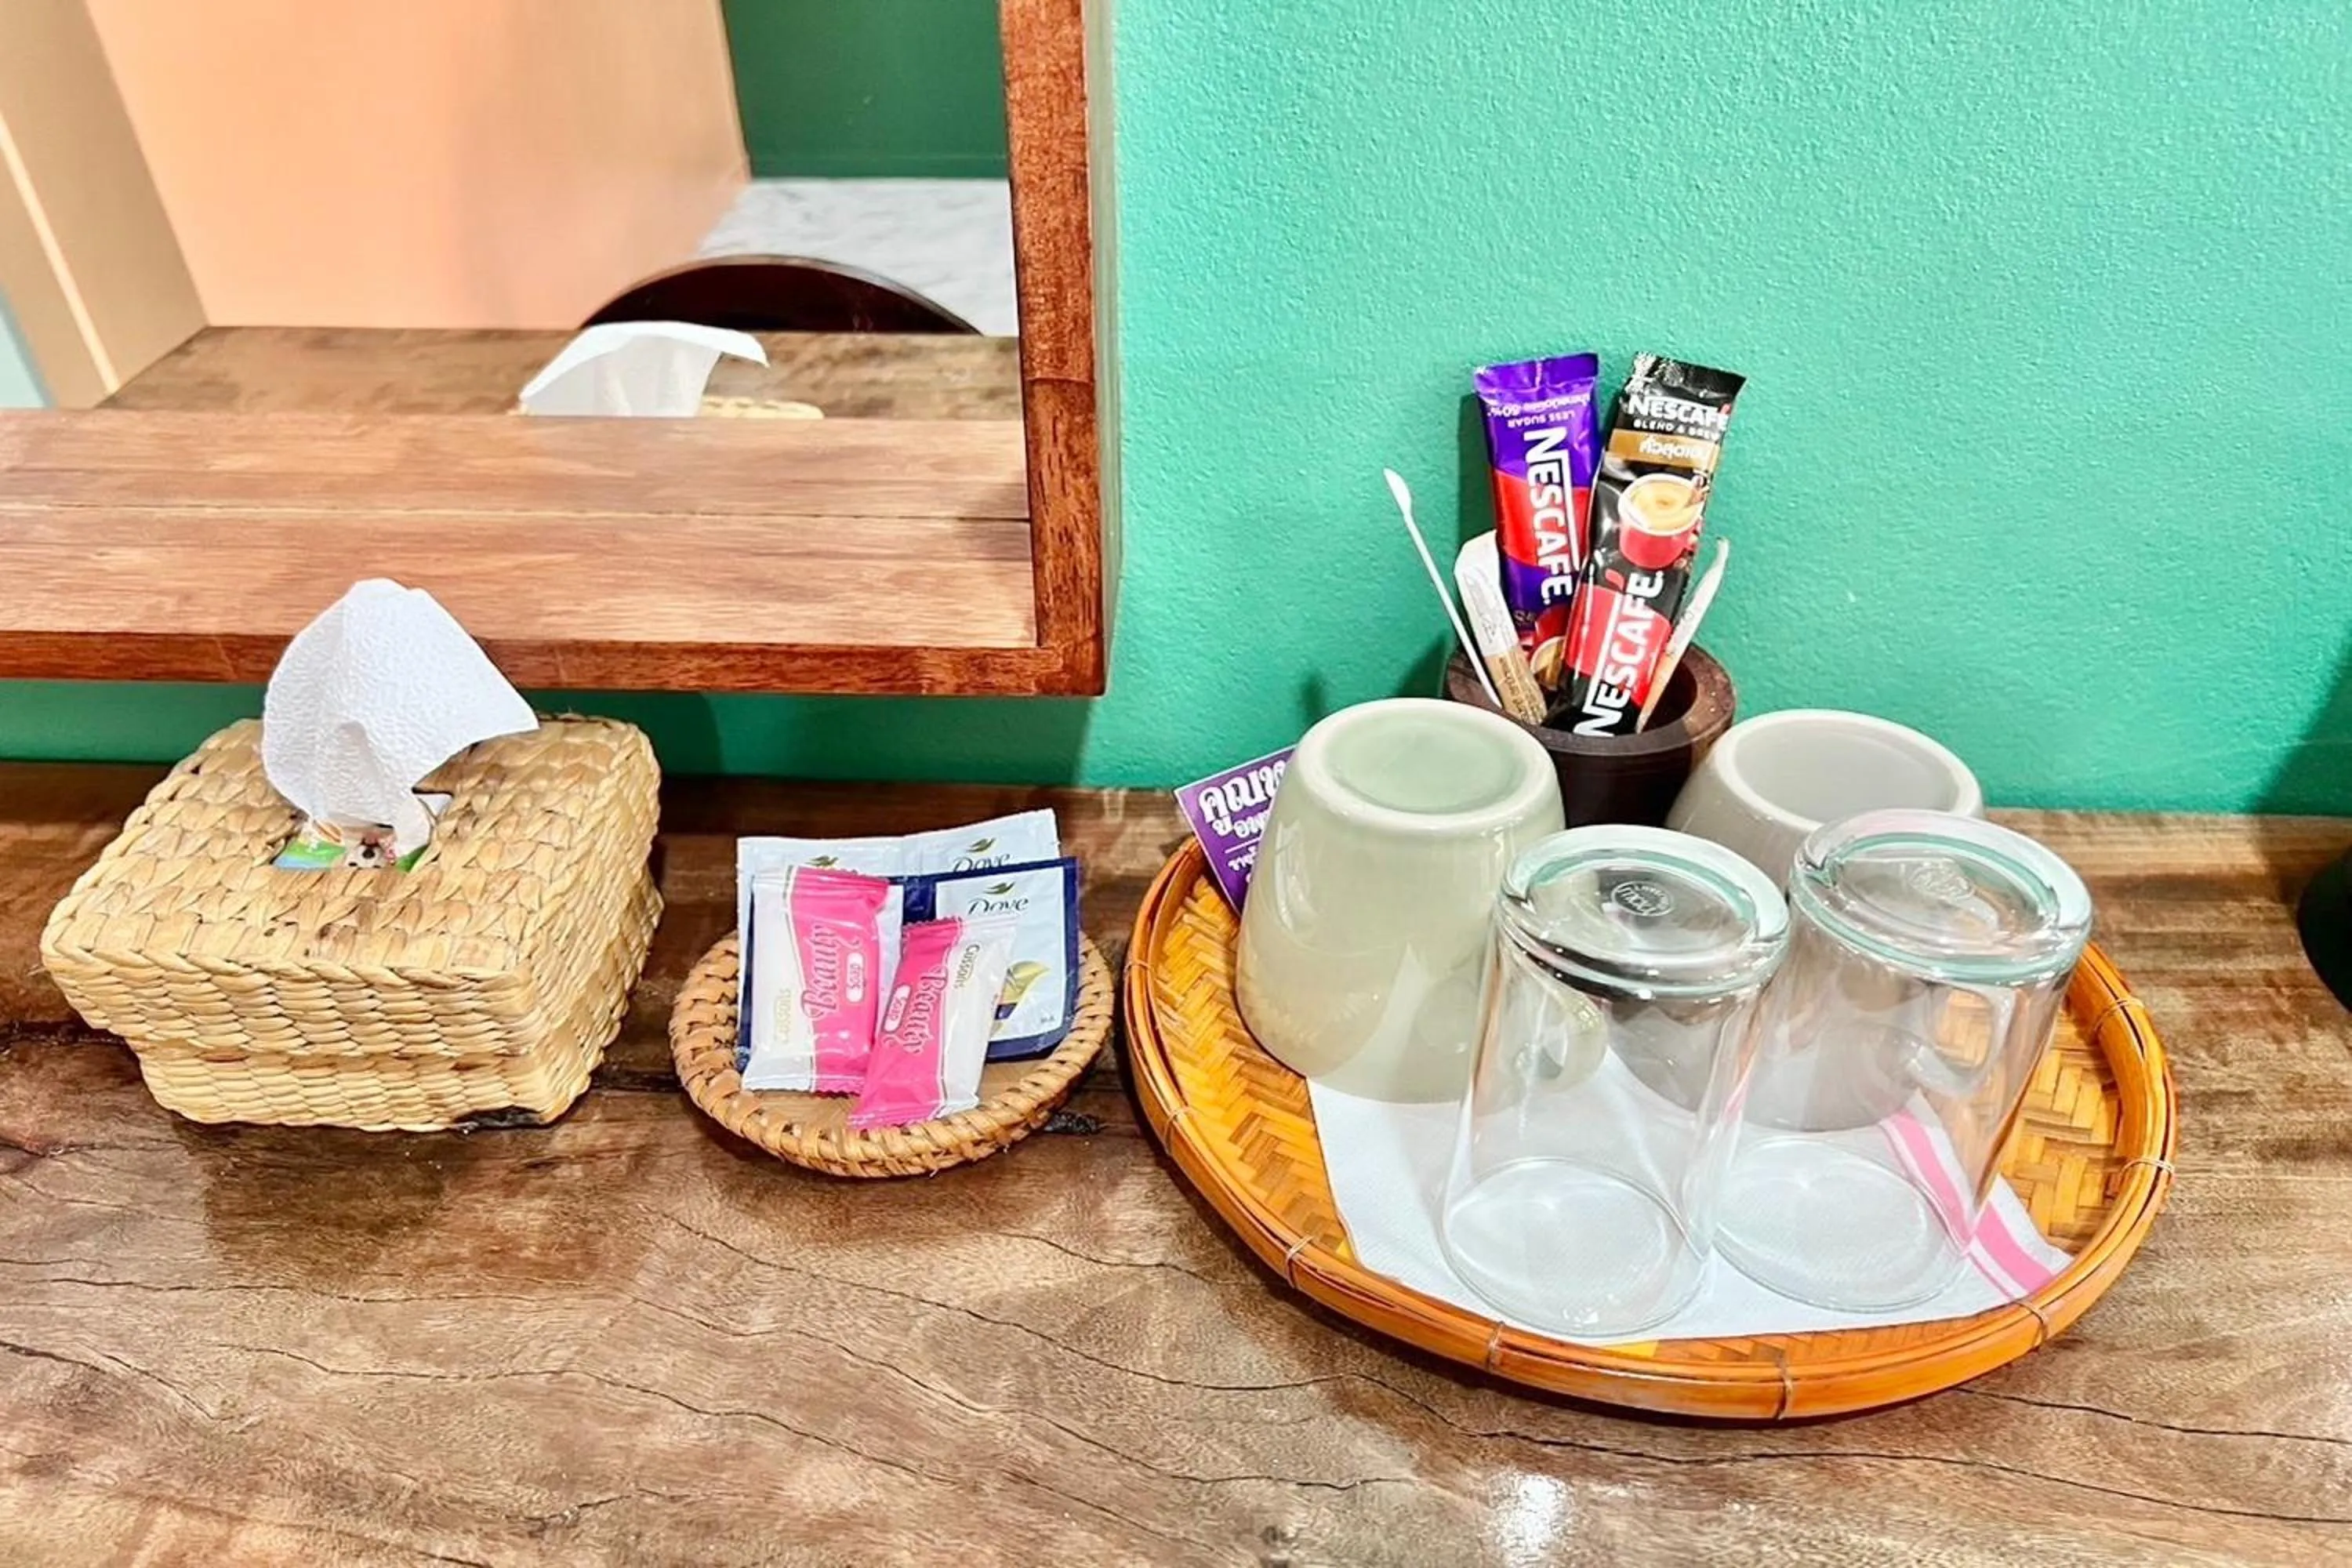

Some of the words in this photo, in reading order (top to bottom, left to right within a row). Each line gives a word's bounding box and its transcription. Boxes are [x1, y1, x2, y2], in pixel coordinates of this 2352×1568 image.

[1508, 414, 1546, 427] SUGAR
[1548, 410, 1574, 423] LESS
[1633, 419, 1674, 432] BLEND
[953, 853, 1010, 873] Dove
[967, 897, 1028, 915] Dove
[800, 924, 860, 1018] Beauty
[953, 943, 980, 989] Cussons
[884, 965, 949, 1054] Beauty
